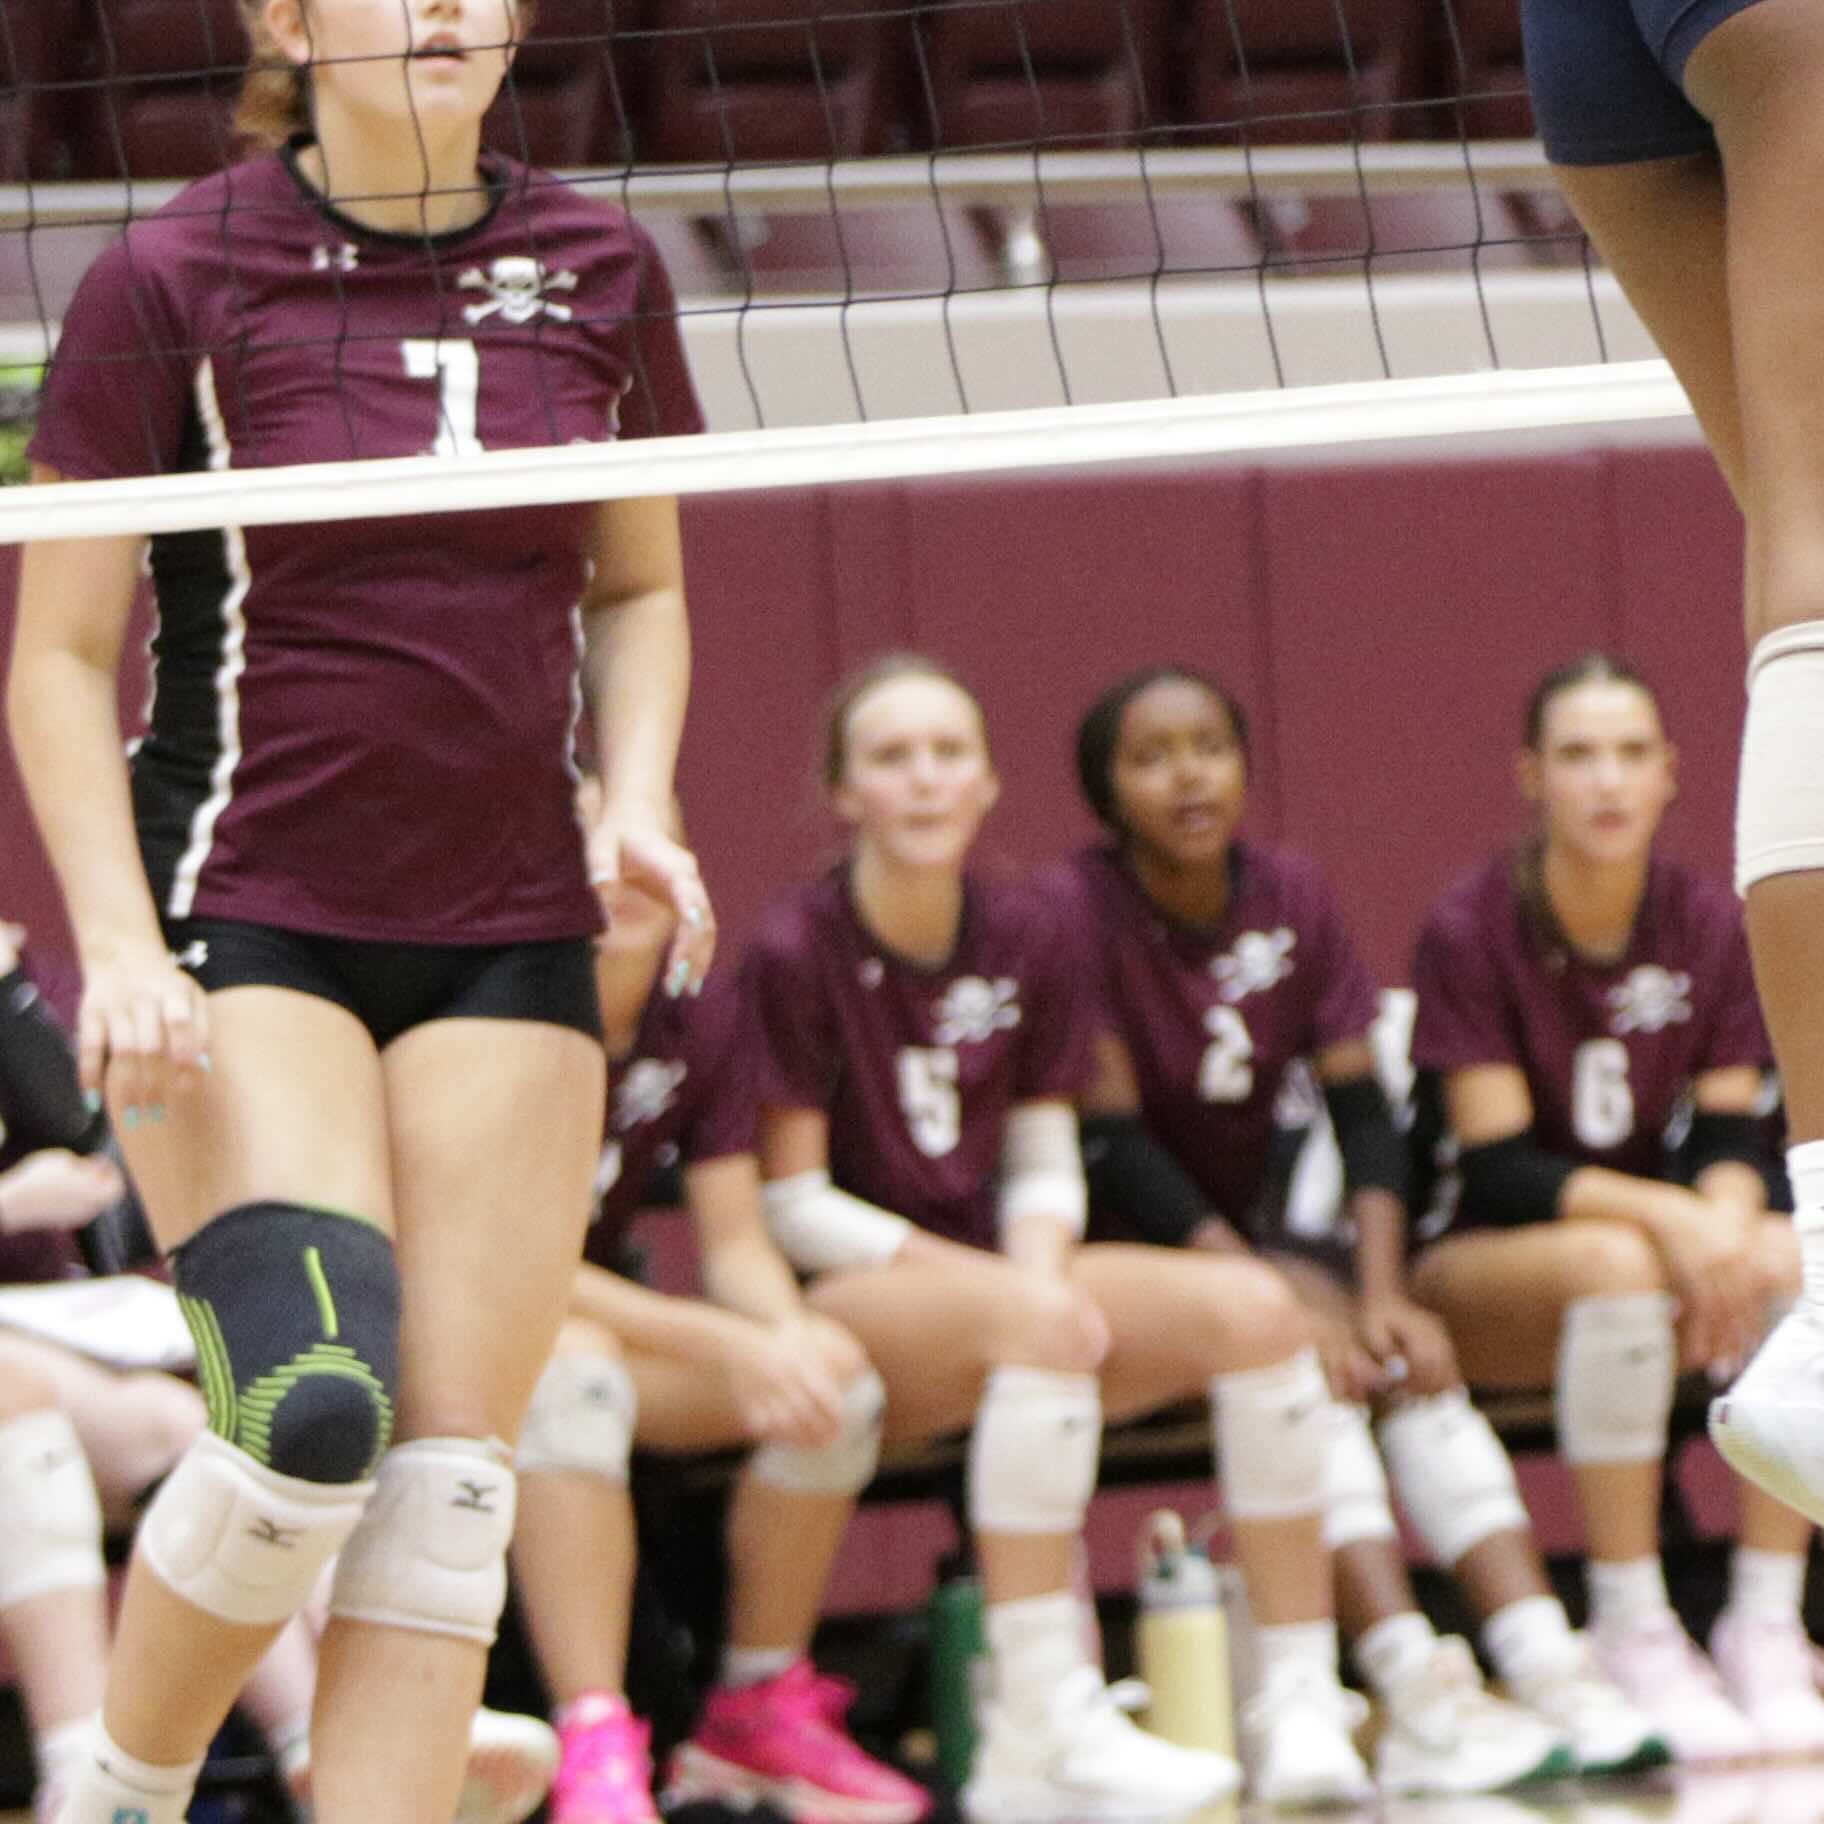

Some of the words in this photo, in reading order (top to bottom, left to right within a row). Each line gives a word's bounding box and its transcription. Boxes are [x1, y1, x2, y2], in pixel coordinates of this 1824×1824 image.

[896, 1044, 962, 1158] 5
[1198, 1004, 1254, 1103] 2
[1571, 1037, 1635, 1148] 6
